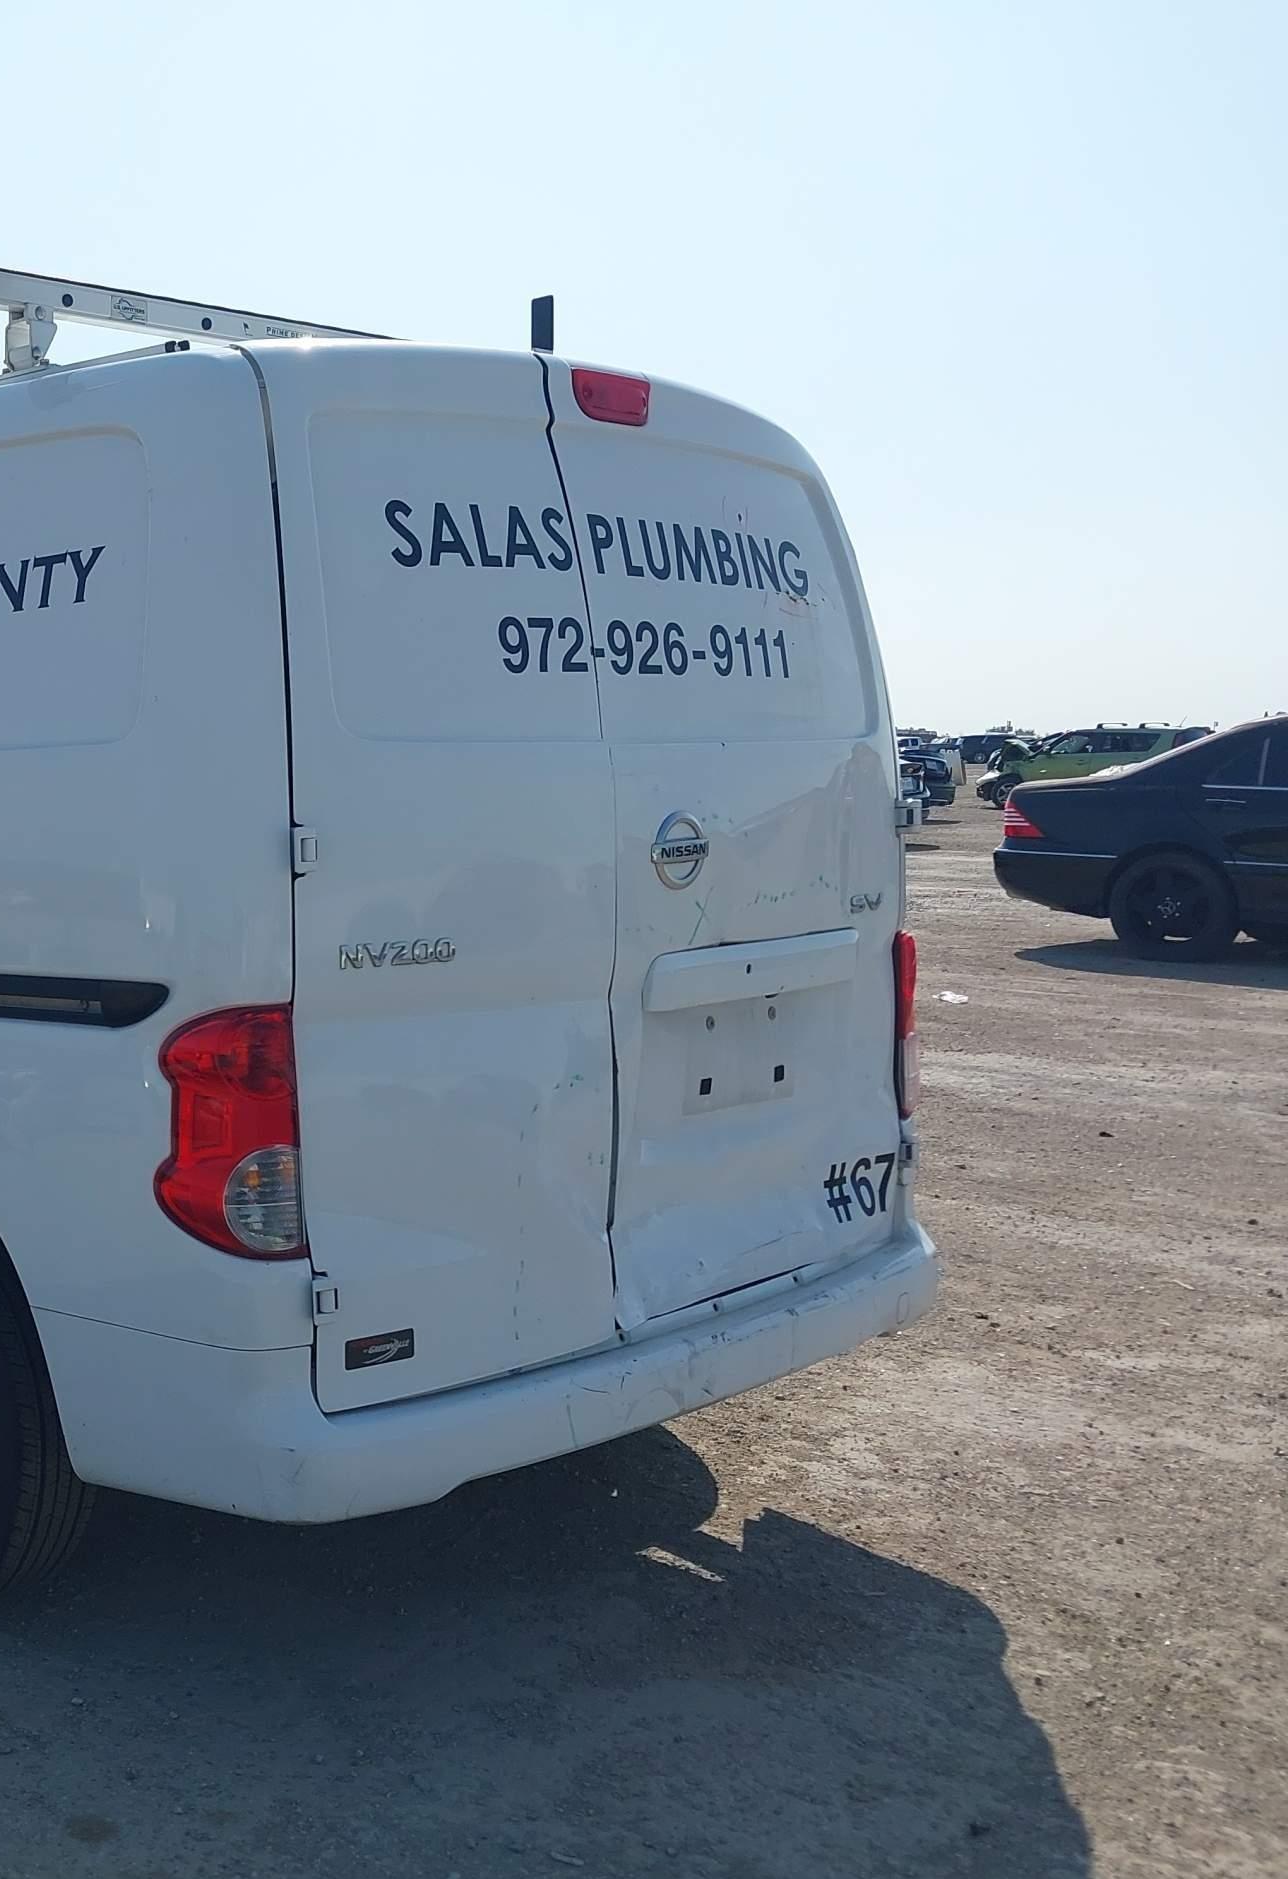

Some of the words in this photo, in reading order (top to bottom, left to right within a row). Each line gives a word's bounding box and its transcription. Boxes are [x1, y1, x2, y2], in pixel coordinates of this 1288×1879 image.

[384, 500, 573, 571] SALAS
[587, 513, 809, 597] PLUMBING
[498, 616, 790, 679] 972-926-9111
[661, 843, 706, 859] NISSAN
[850, 893, 882, 914] SV
[338, 937, 456, 970] NV200
[823, 1152, 896, 1224] #67
